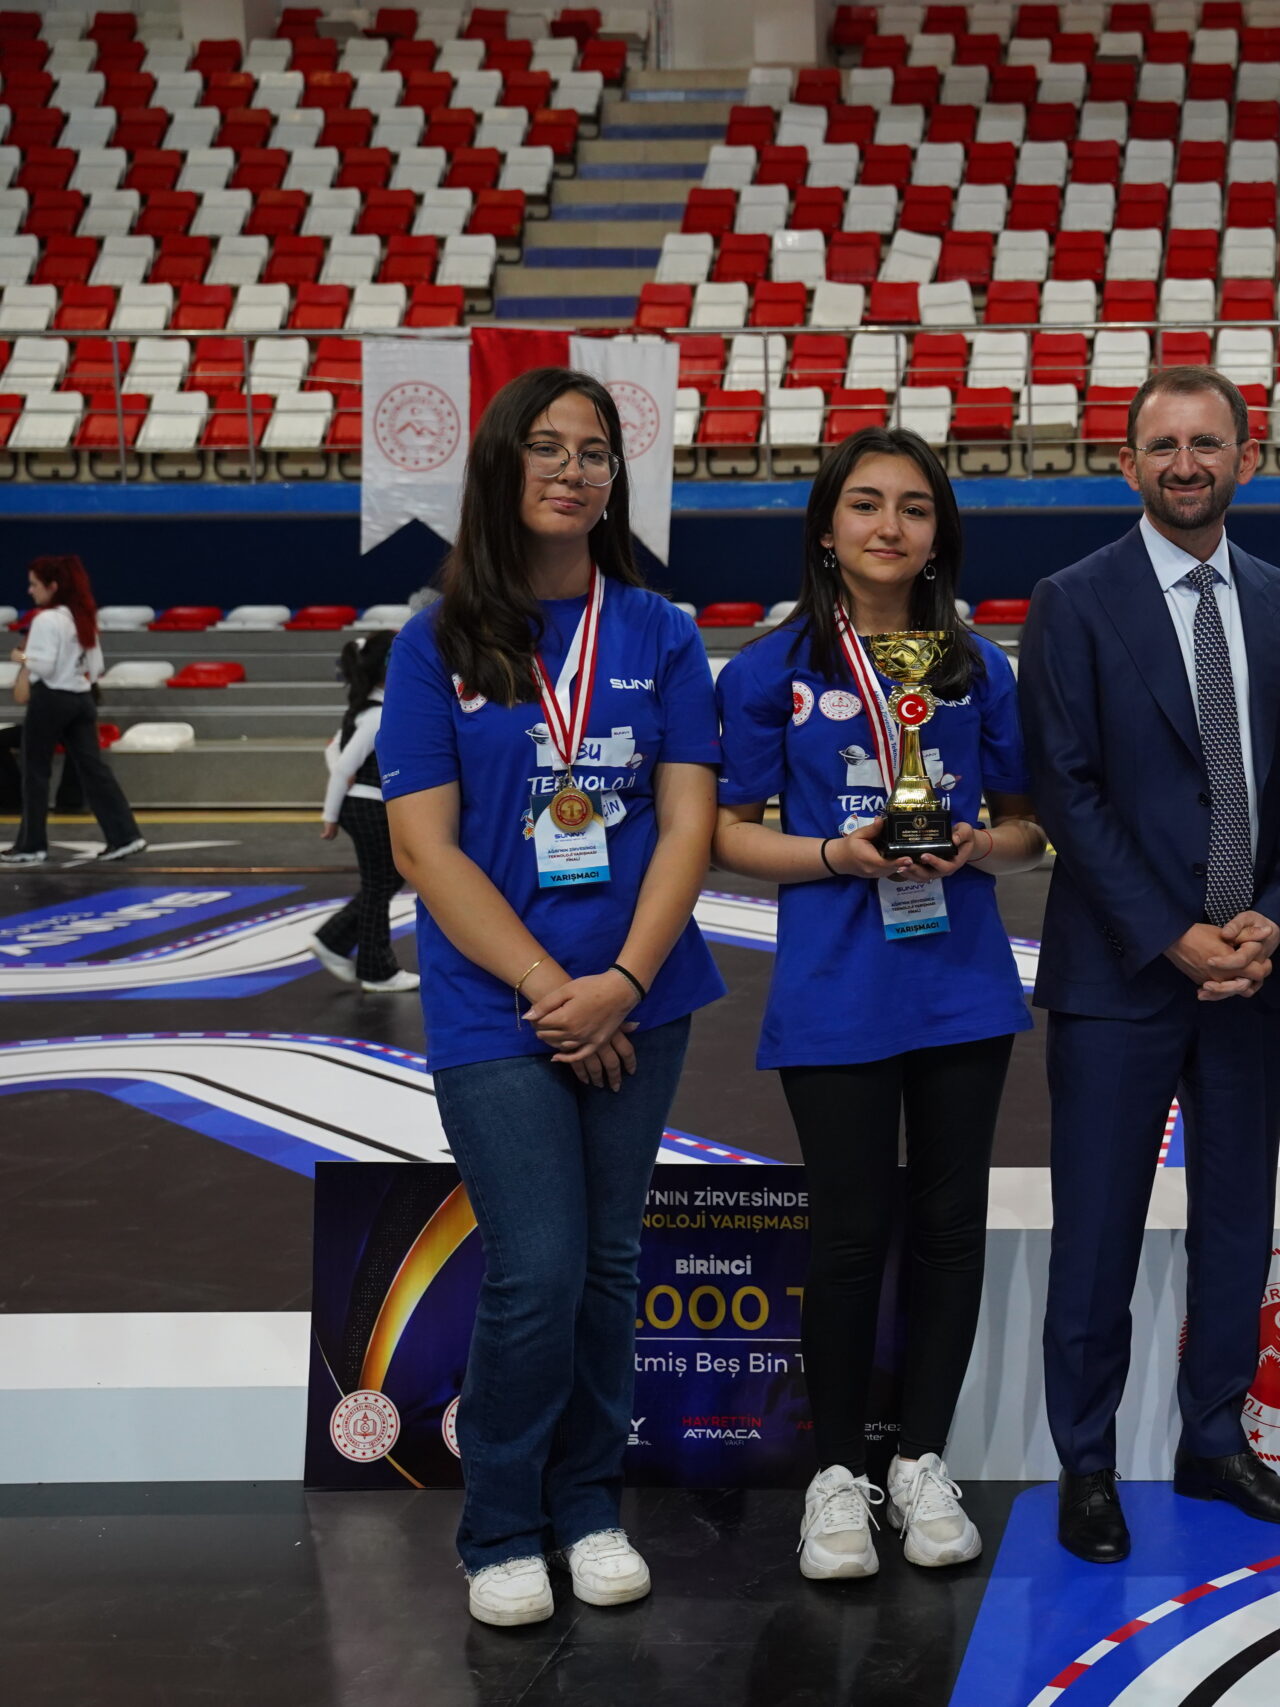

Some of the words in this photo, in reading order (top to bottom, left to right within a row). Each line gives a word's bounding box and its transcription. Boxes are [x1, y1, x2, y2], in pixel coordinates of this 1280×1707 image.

[550, 871, 600, 882] YARIŞMACI
[694, 1186, 809, 1208] ZİRVESİNDE
[710, 1214, 809, 1233] YARIŞMASI
[675, 1254, 752, 1275] BİRİNCİ
[696, 1352, 741, 1378] Beş
[750, 1353, 788, 1373] Bin
[682, 1414, 763, 1428] HAYRETTİN
[683, 1428, 762, 1440] ATMACA
